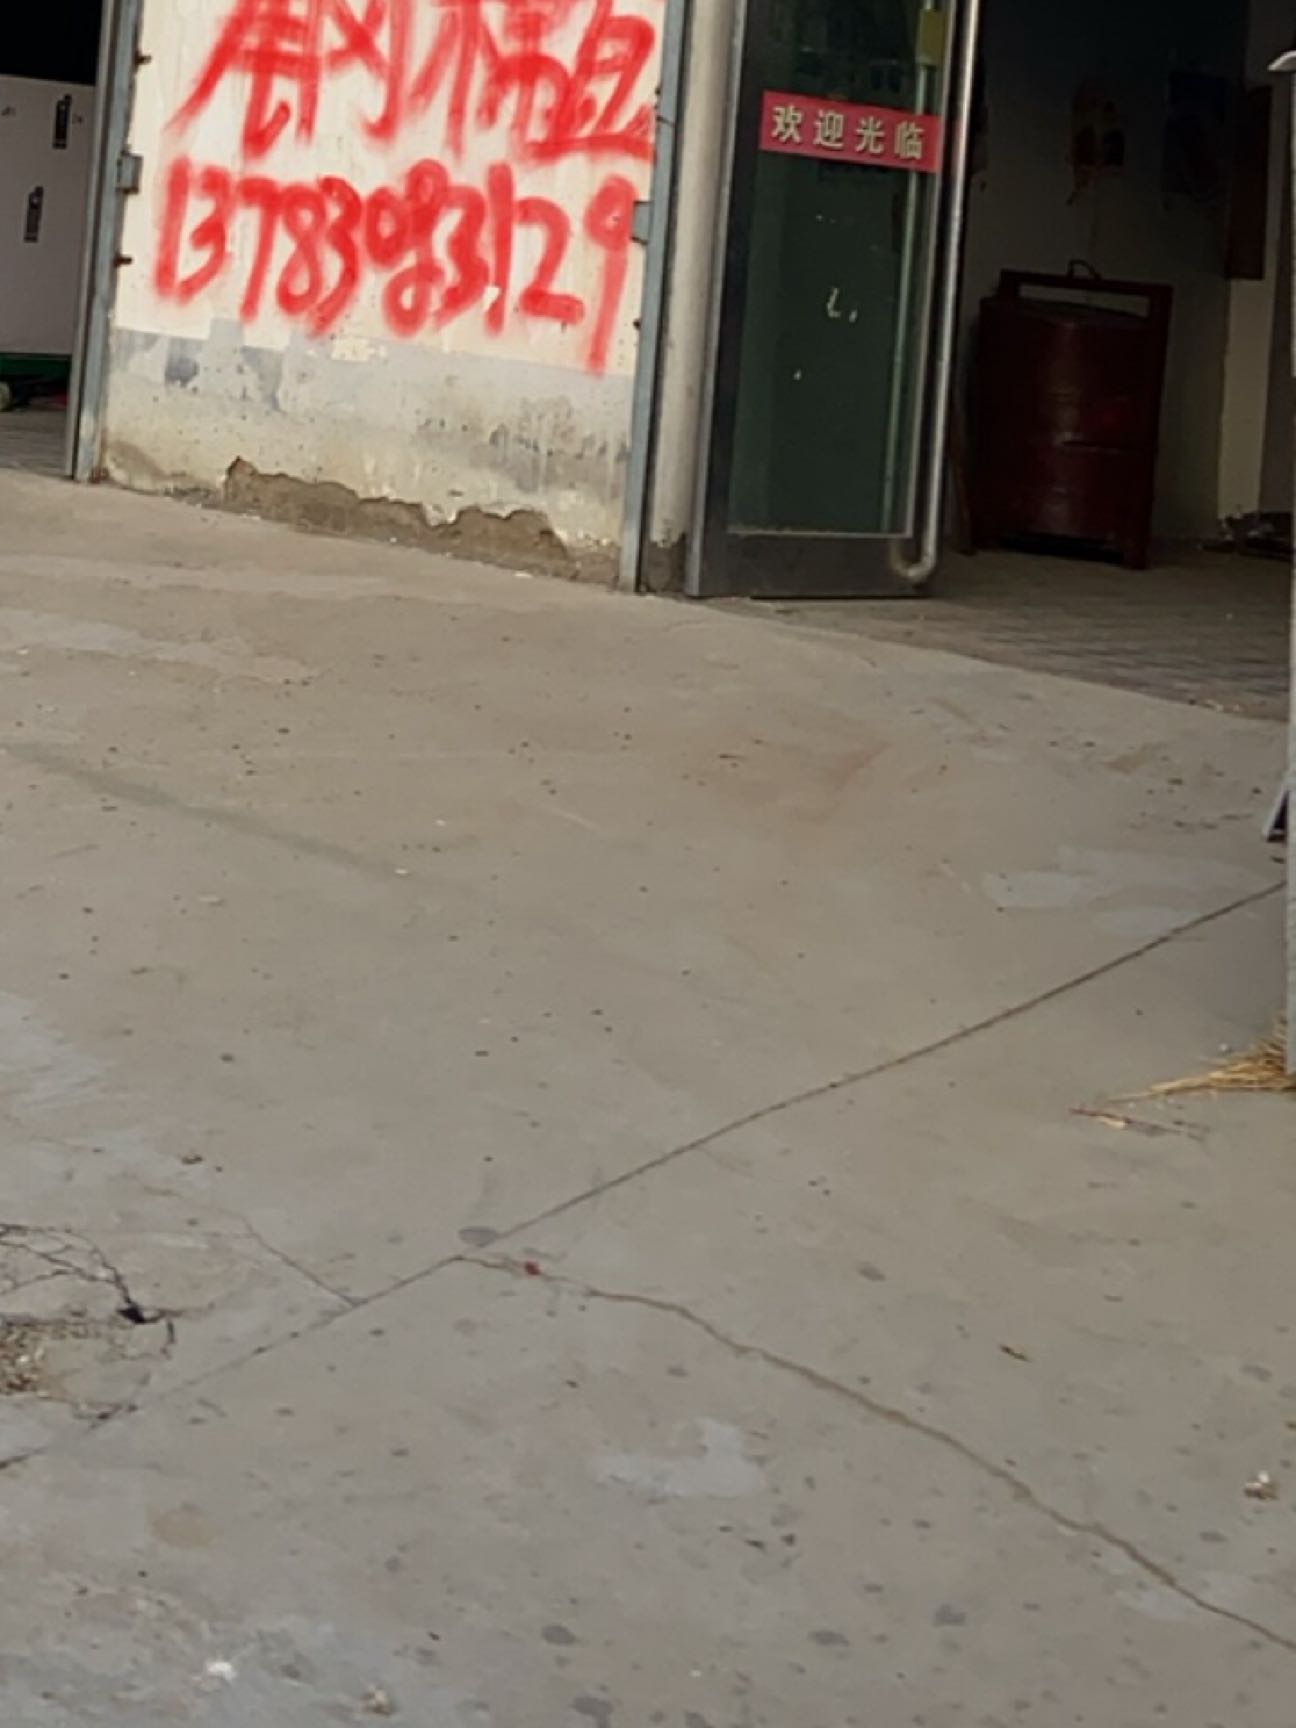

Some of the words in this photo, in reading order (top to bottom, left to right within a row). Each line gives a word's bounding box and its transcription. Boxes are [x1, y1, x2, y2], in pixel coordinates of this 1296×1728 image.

[771, 104, 925, 161] 欢迎光临
[153, 158, 639, 378] 13783083129
